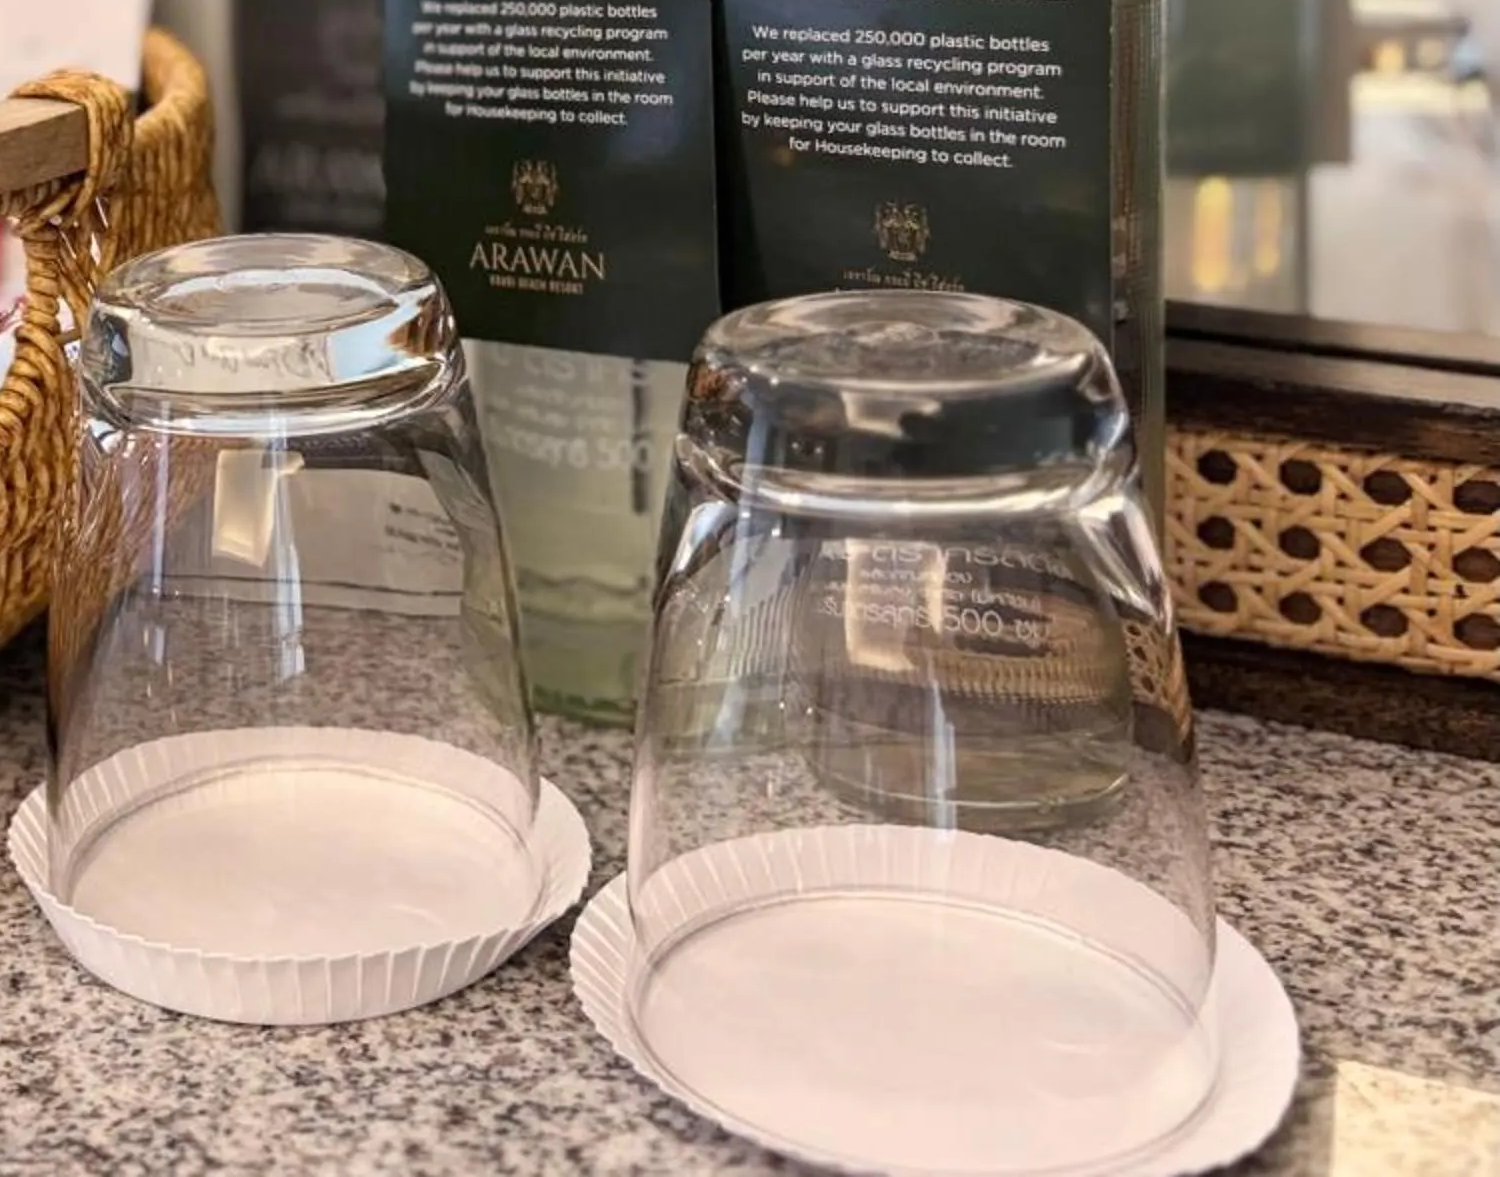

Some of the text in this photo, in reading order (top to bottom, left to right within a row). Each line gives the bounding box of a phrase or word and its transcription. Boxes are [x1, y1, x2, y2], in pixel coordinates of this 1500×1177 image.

[560, 3, 604, 18] plastic
[607, 3, 657, 18] bottles
[505, 23, 538, 39] glass
[541, 24, 603, 41] recycling
[605, 26, 668, 42] program
[752, 25, 778, 40] We
[783, 27, 850, 44] replaced
[930, 32, 985, 49] plastic
[989, 36, 1050, 52] bottles
[487, 42, 501, 56] of
[503, 43, 525, 57] the
[528, 44, 560, 58] local
[742, 49, 1062, 77] per year with a glass recycling program
[485, 65, 500, 77] us
[503, 64, 517, 78] to
[520, 67, 572, 81] support
[574, 67, 600, 81] this
[604, 68, 666, 84] initiative
[757, 69, 1044, 99] in support of the local environment.
[476, 85, 504, 99] your
[507, 85, 540, 100] glass
[542, 87, 589, 102] bottles
[591, 89, 605, 102] in
[607, 90, 631, 103] the
[634, 93, 673, 105] room
[747, 89, 1058, 124] Please help us to support this initiative
[560, 109, 575, 122] to
[741, 110, 1067, 148] by keeping your glass bottles in the room
[789, 136, 1013, 168] for Housekeeping to collect.
[469, 241, 606, 281] ARAWAN
[944, 606, 1002, 637] 500
